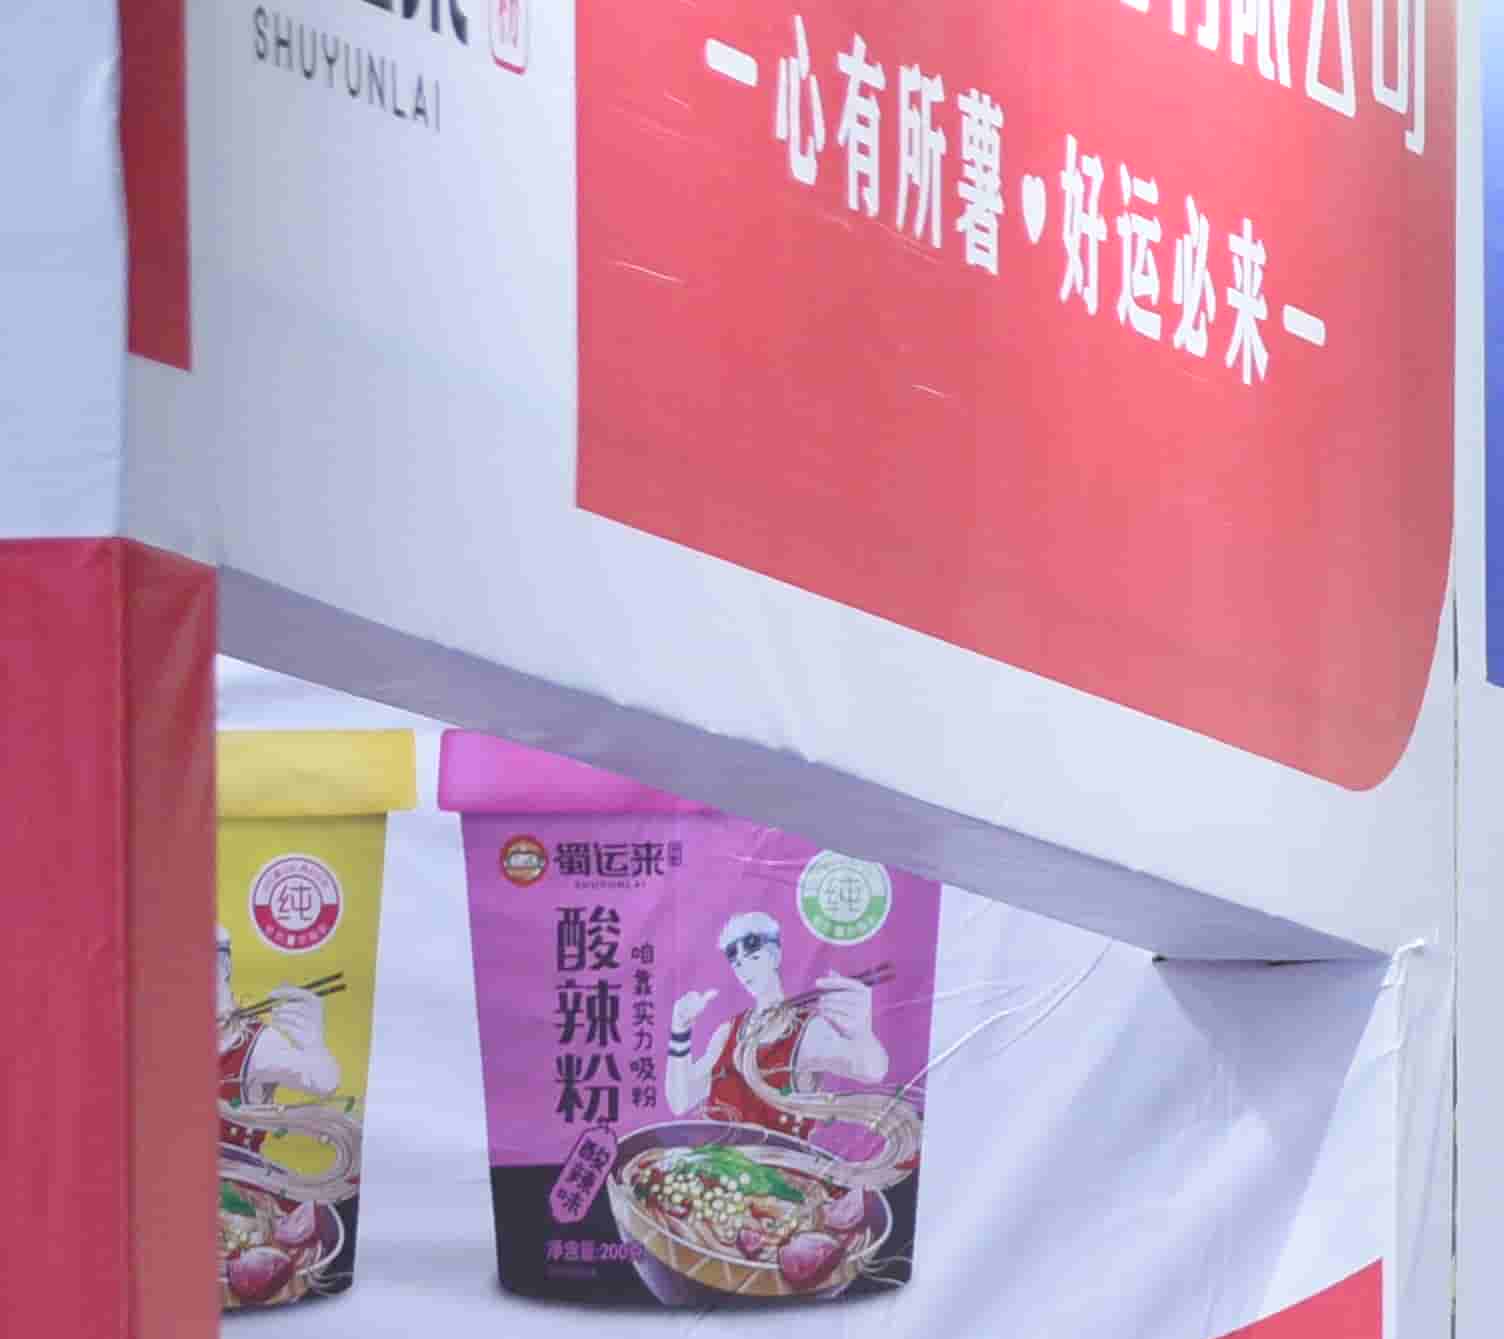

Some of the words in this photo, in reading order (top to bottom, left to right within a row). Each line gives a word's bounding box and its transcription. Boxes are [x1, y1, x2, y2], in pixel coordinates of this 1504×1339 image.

[252, 6, 441, 133] SHUYUNLAI
[775, 12, 1004, 276] 心有所薯
[1058, 133, 1270, 385] 好运必来
[553, 839, 667, 878] 蜀运来
[555, 904, 622, 1125] 酸辣粉
[630, 941, 657, 1111] 咱靠实力吸粉
